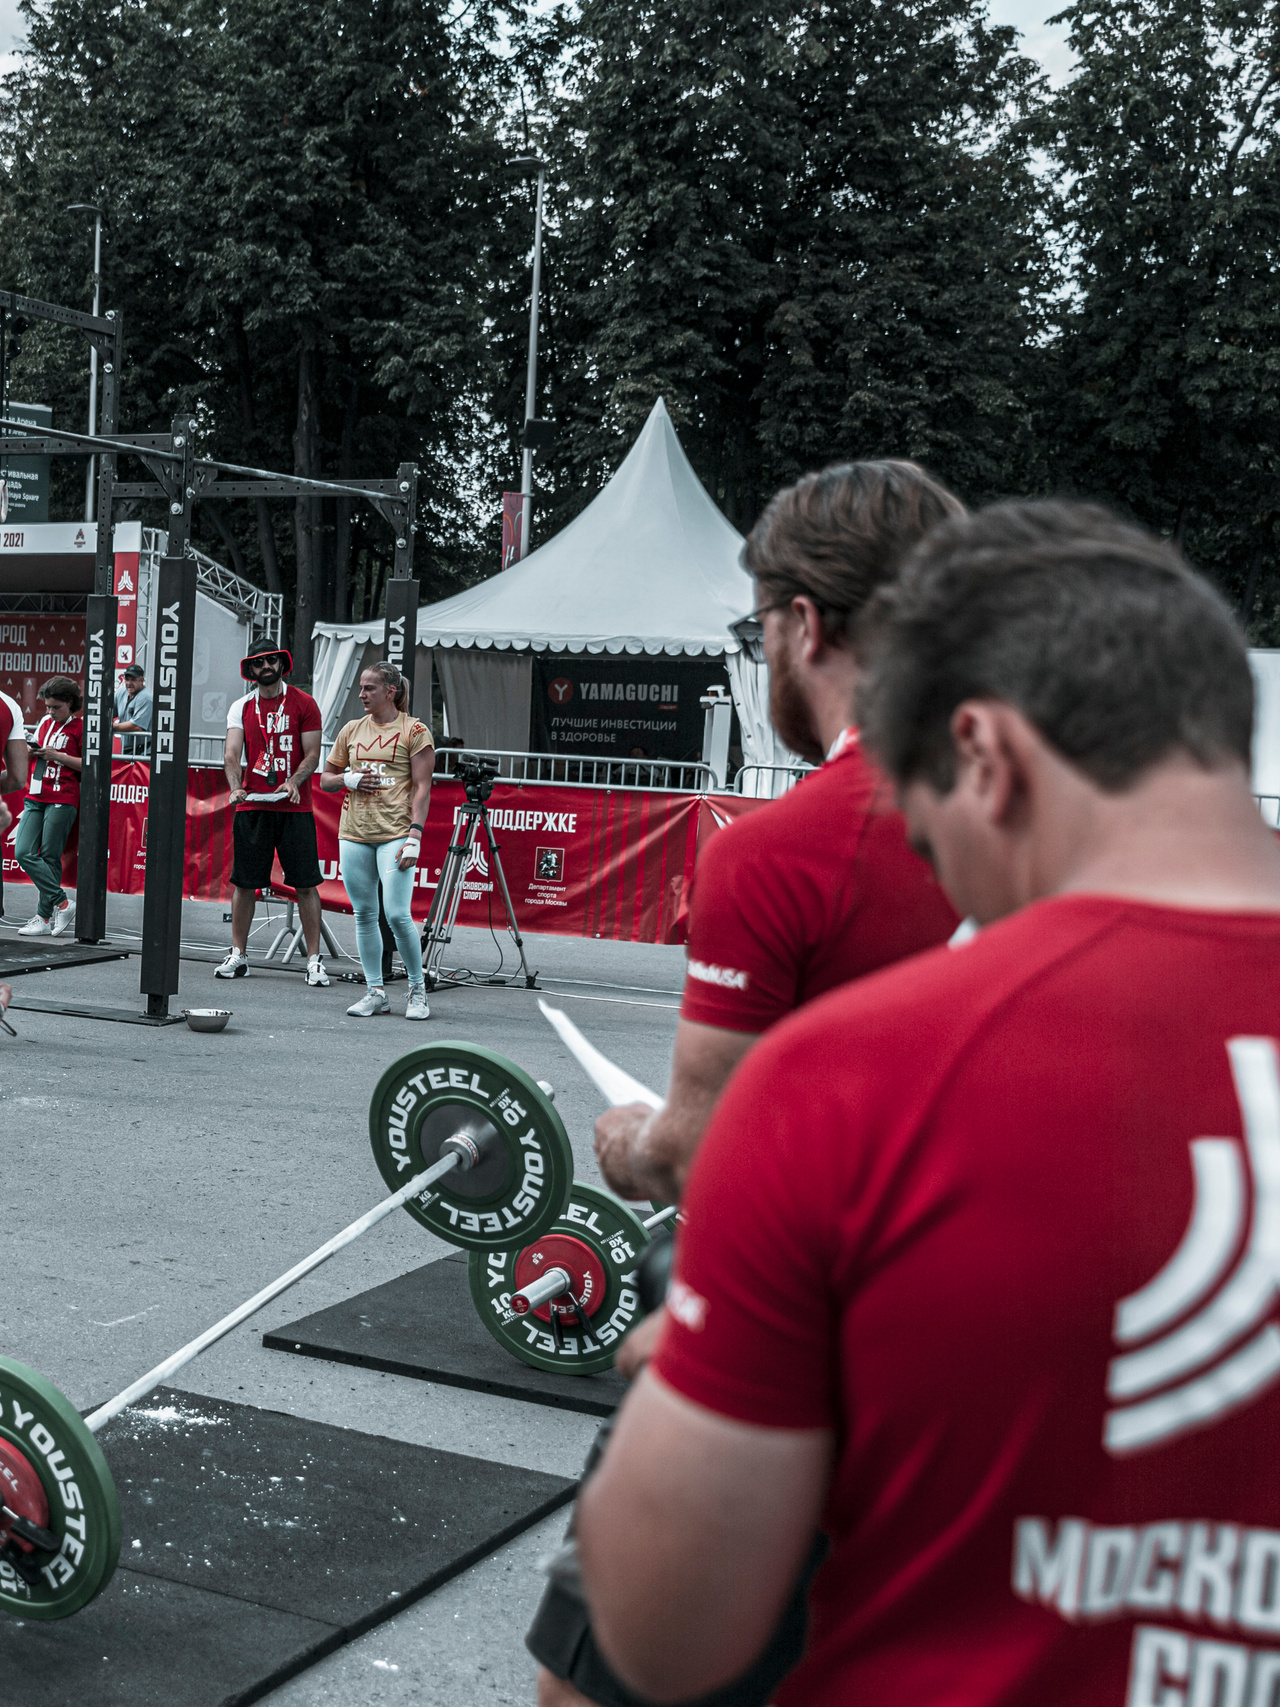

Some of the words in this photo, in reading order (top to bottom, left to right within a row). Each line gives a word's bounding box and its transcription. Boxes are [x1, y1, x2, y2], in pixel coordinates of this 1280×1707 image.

[22, 492, 40, 502] Square
[3, 532, 24, 547] 2021
[34, 653, 85, 674] ПОЛЬЗУ
[85, 629, 104, 766] YOUSTEEL
[155, 601, 181, 774] YOUSTEEL
[579, 682, 679, 702] YAMAGUCHI
[551, 717, 598, 729] ЛУЧШИЕ
[600, 718, 677, 731] ИНВЕСТИЦИИ
[551, 732, 557, 741] В
[559, 732, 616, 743] ЗДОРОВЬЕ
[110, 784, 149, 804] ОДДЕР
[488, 809, 577, 834] ПОДДЕРЖКЕ
[463, 890, 482, 901] СПОРТ
[528, 882, 566, 891] Департамент
[545, 898, 568, 907] Москвы
[497, 1095, 512, 1110] KG
[388, 1067, 489, 1172] YOUSTEEL
[502, 1100, 527, 1126] 10
[440, 1128, 544, 1234] YOUSTEEL
[418, 1190, 432, 1204] KG
[608, 1236, 624, 1248] KG
[610, 1241, 635, 1264] 10
[490, 1292, 512, 1315] 10
[521, 1269, 640, 1355] YOUSTEEL
[12, 1399, 87, 1590] YOUSTEEL
